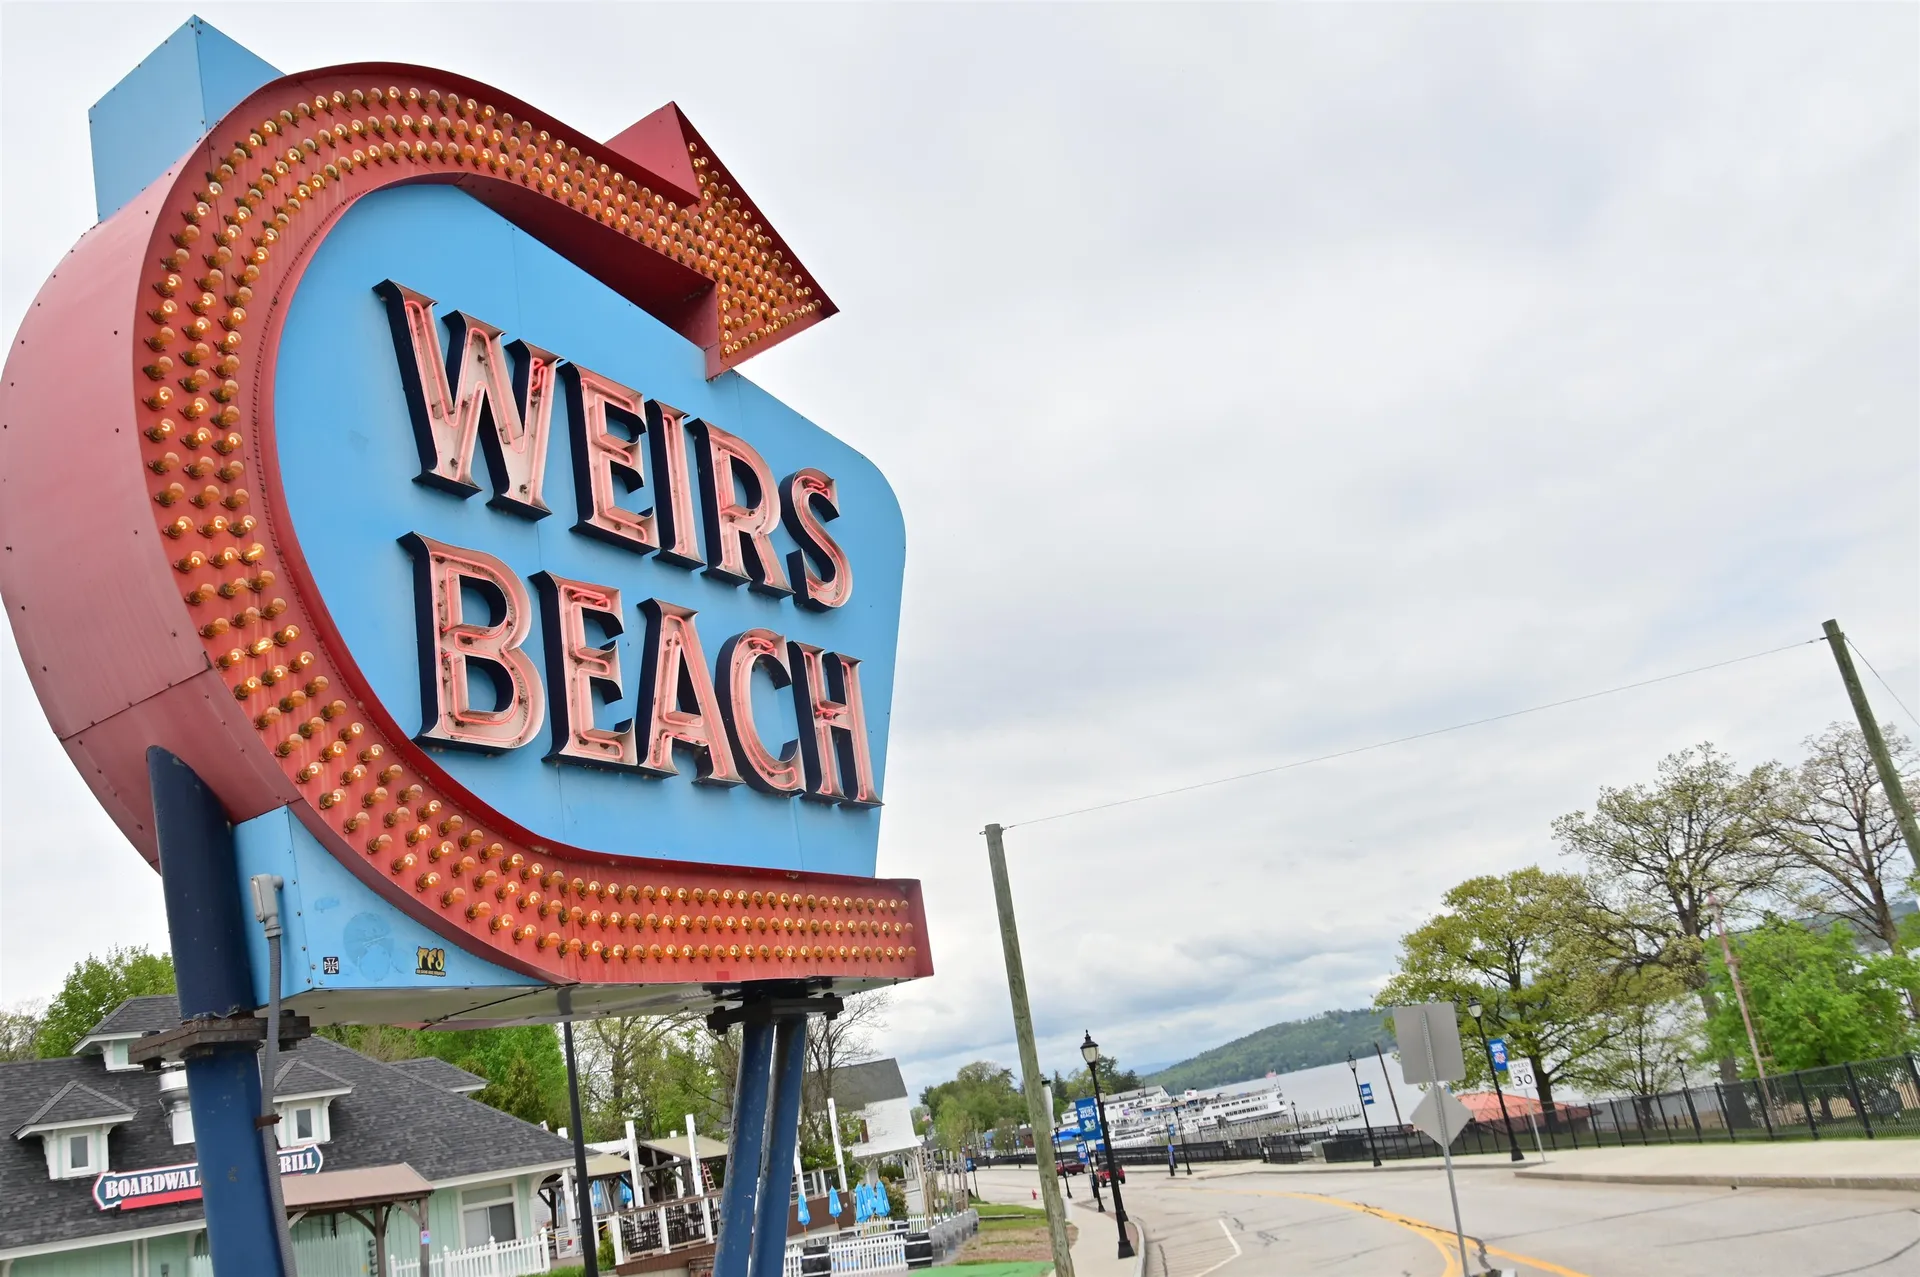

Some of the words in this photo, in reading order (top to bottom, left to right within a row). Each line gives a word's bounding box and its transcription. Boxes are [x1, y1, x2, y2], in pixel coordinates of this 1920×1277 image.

[372, 279, 853, 613] WEIRS
[396, 531, 886, 808] BEACH
[1510, 1061, 1530, 1069] SPEED
[1514, 1074, 1533, 1087] 30
[105, 1168, 201, 1200] BOARDWAL
[277, 1152, 316, 1174] RILL
